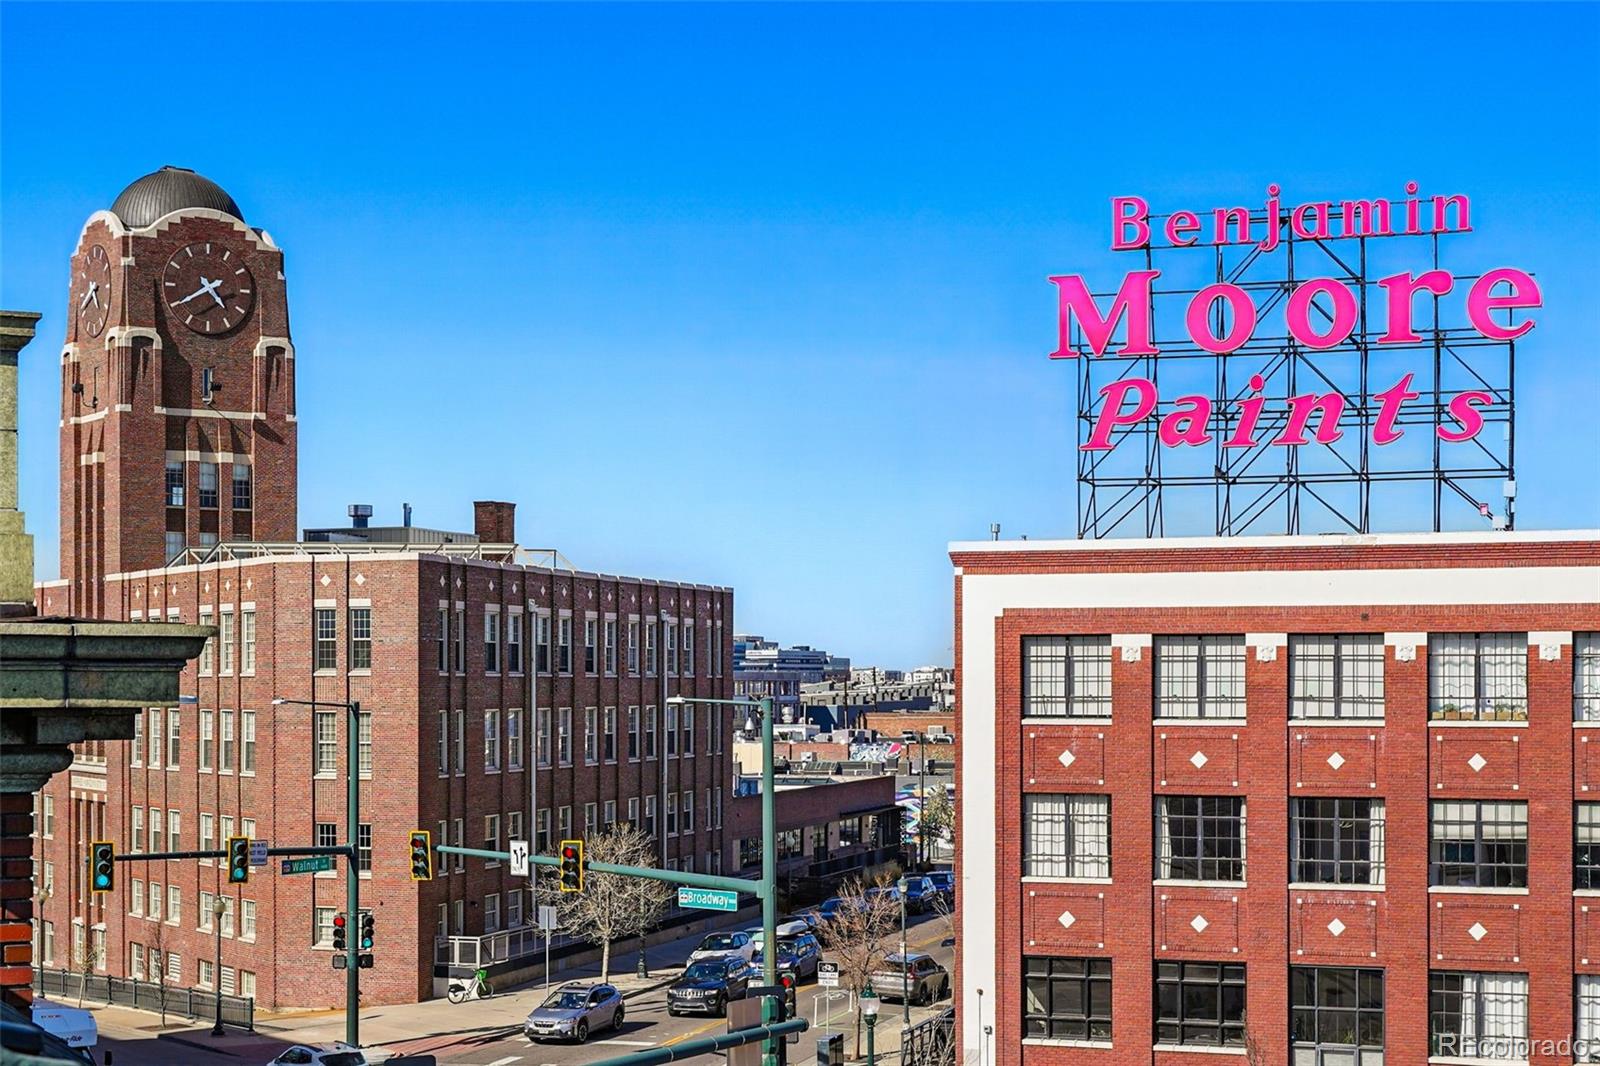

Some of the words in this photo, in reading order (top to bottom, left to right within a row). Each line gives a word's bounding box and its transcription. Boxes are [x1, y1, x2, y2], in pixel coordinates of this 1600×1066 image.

[1111, 181, 1473, 252] Benjamin
[1048, 267, 1543, 359] Moore
[1079, 373, 1493, 451] Paints
[292, 859, 319, 872] Walnut
[688, 891, 729, 909] Broadway
